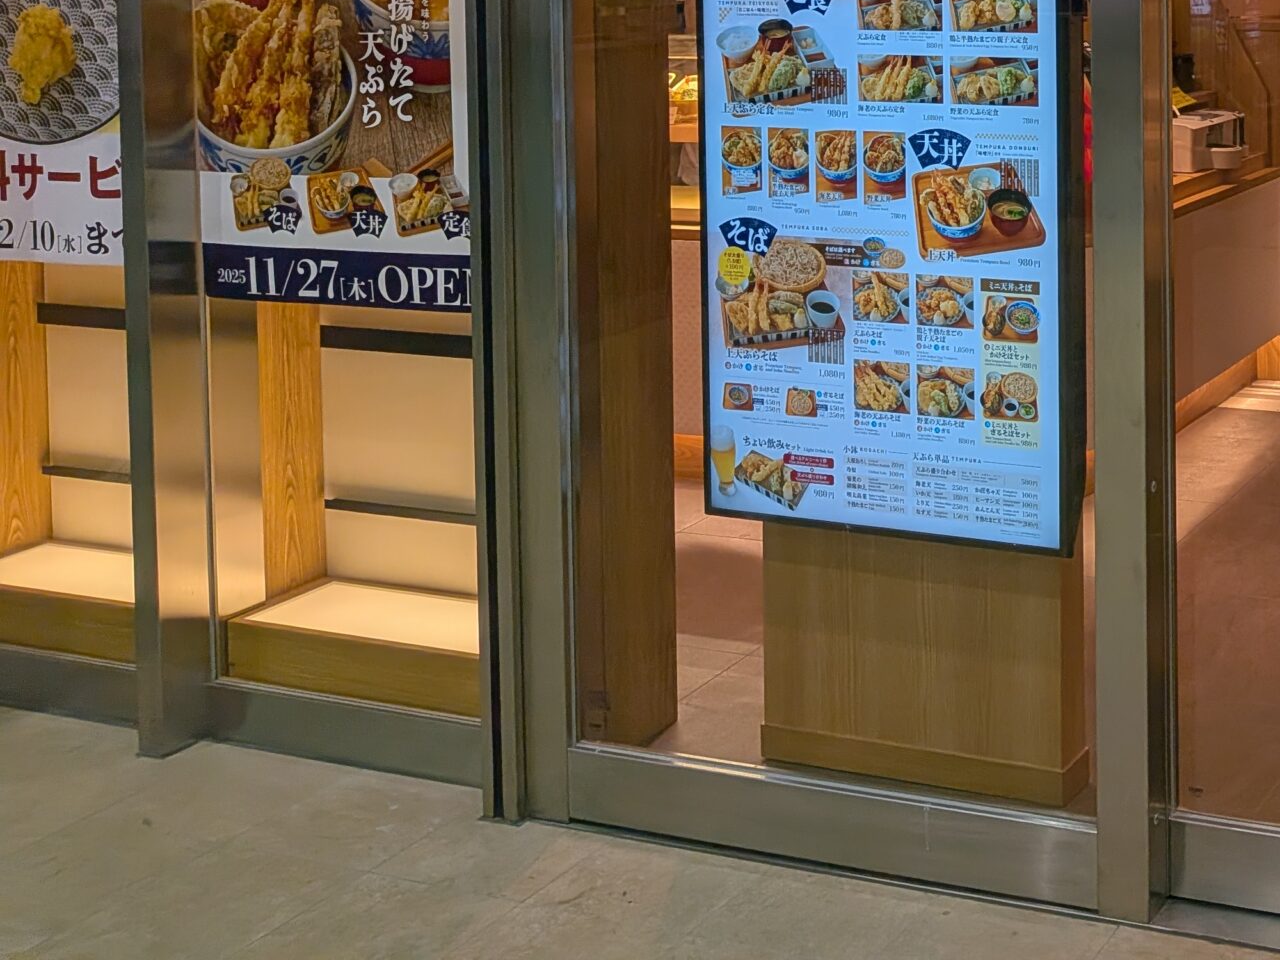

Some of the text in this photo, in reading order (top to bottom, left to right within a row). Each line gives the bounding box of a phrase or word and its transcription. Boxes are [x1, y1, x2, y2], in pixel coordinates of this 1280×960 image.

[358, 28, 385, 130] 天ぷら
[722, 102, 775, 116] 上天ぷら定食
[916, 131, 963, 166] 天丼
[0, 150, 121, 202] サービ
[267, 206, 297, 232] そば
[351, 210, 384, 235] 天丼
[0, 218, 123, 255] 2/10[水]ま
[727, 220, 770, 253] そば
[928, 249, 1041, 269] 上天丼 980円
[217, 267, 246, 285] 2025
[742, 435, 801, 452] ちょい飲みセット
